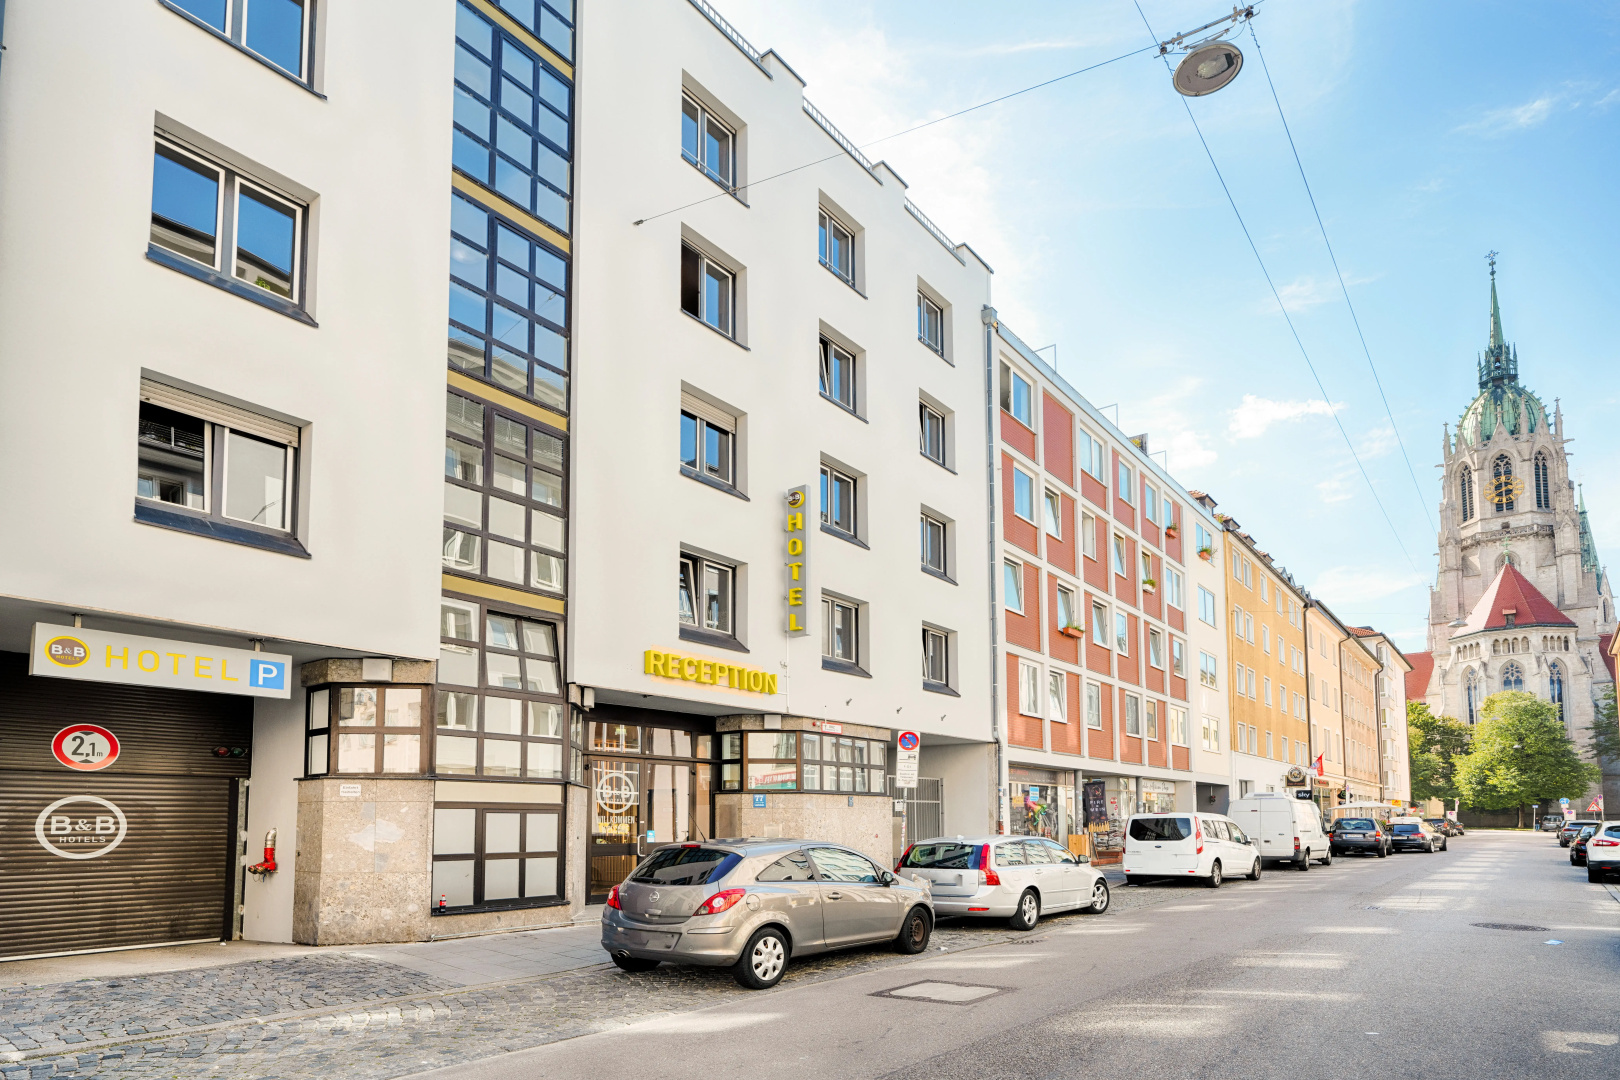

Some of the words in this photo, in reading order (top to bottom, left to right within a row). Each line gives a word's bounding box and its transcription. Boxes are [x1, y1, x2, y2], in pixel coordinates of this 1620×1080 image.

[788, 512, 803, 631] HOTEL
[51, 644, 85, 657] B&B
[105, 645, 239, 682] HOTEL
[258, 663, 278, 685] P
[644, 649, 778, 695] RECEPTION
[50, 815, 116, 835] B&B
[597, 815, 635, 824] WILLKOMMEN
